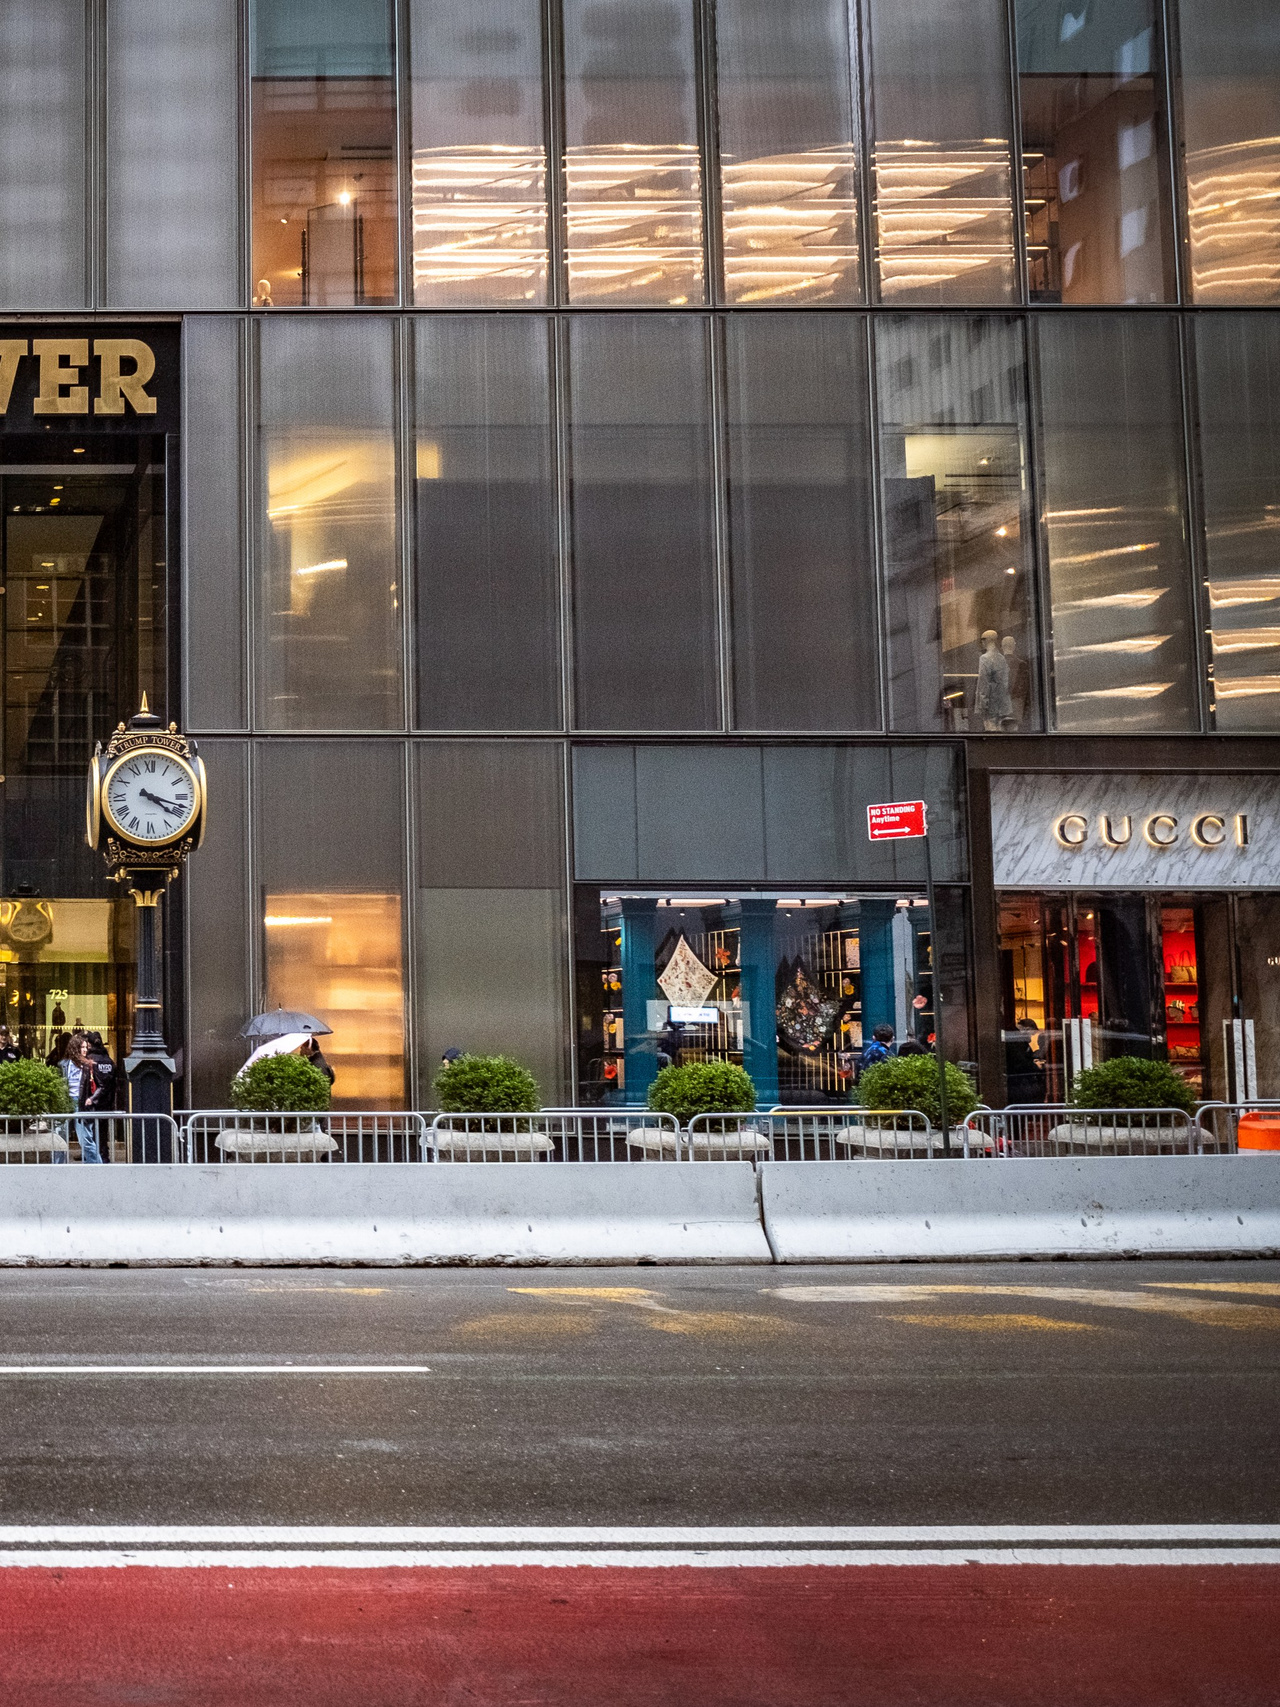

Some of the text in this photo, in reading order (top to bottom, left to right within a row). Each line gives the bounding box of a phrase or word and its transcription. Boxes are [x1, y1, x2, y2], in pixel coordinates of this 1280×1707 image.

[117, 735, 181, 751] TRUMP TOWER
[882, 805, 915, 815] STANDING
[871, 815, 900, 824] Anytime
[1054, 814, 1249, 846] GUCCI
[49, 989, 68, 1000] 725
